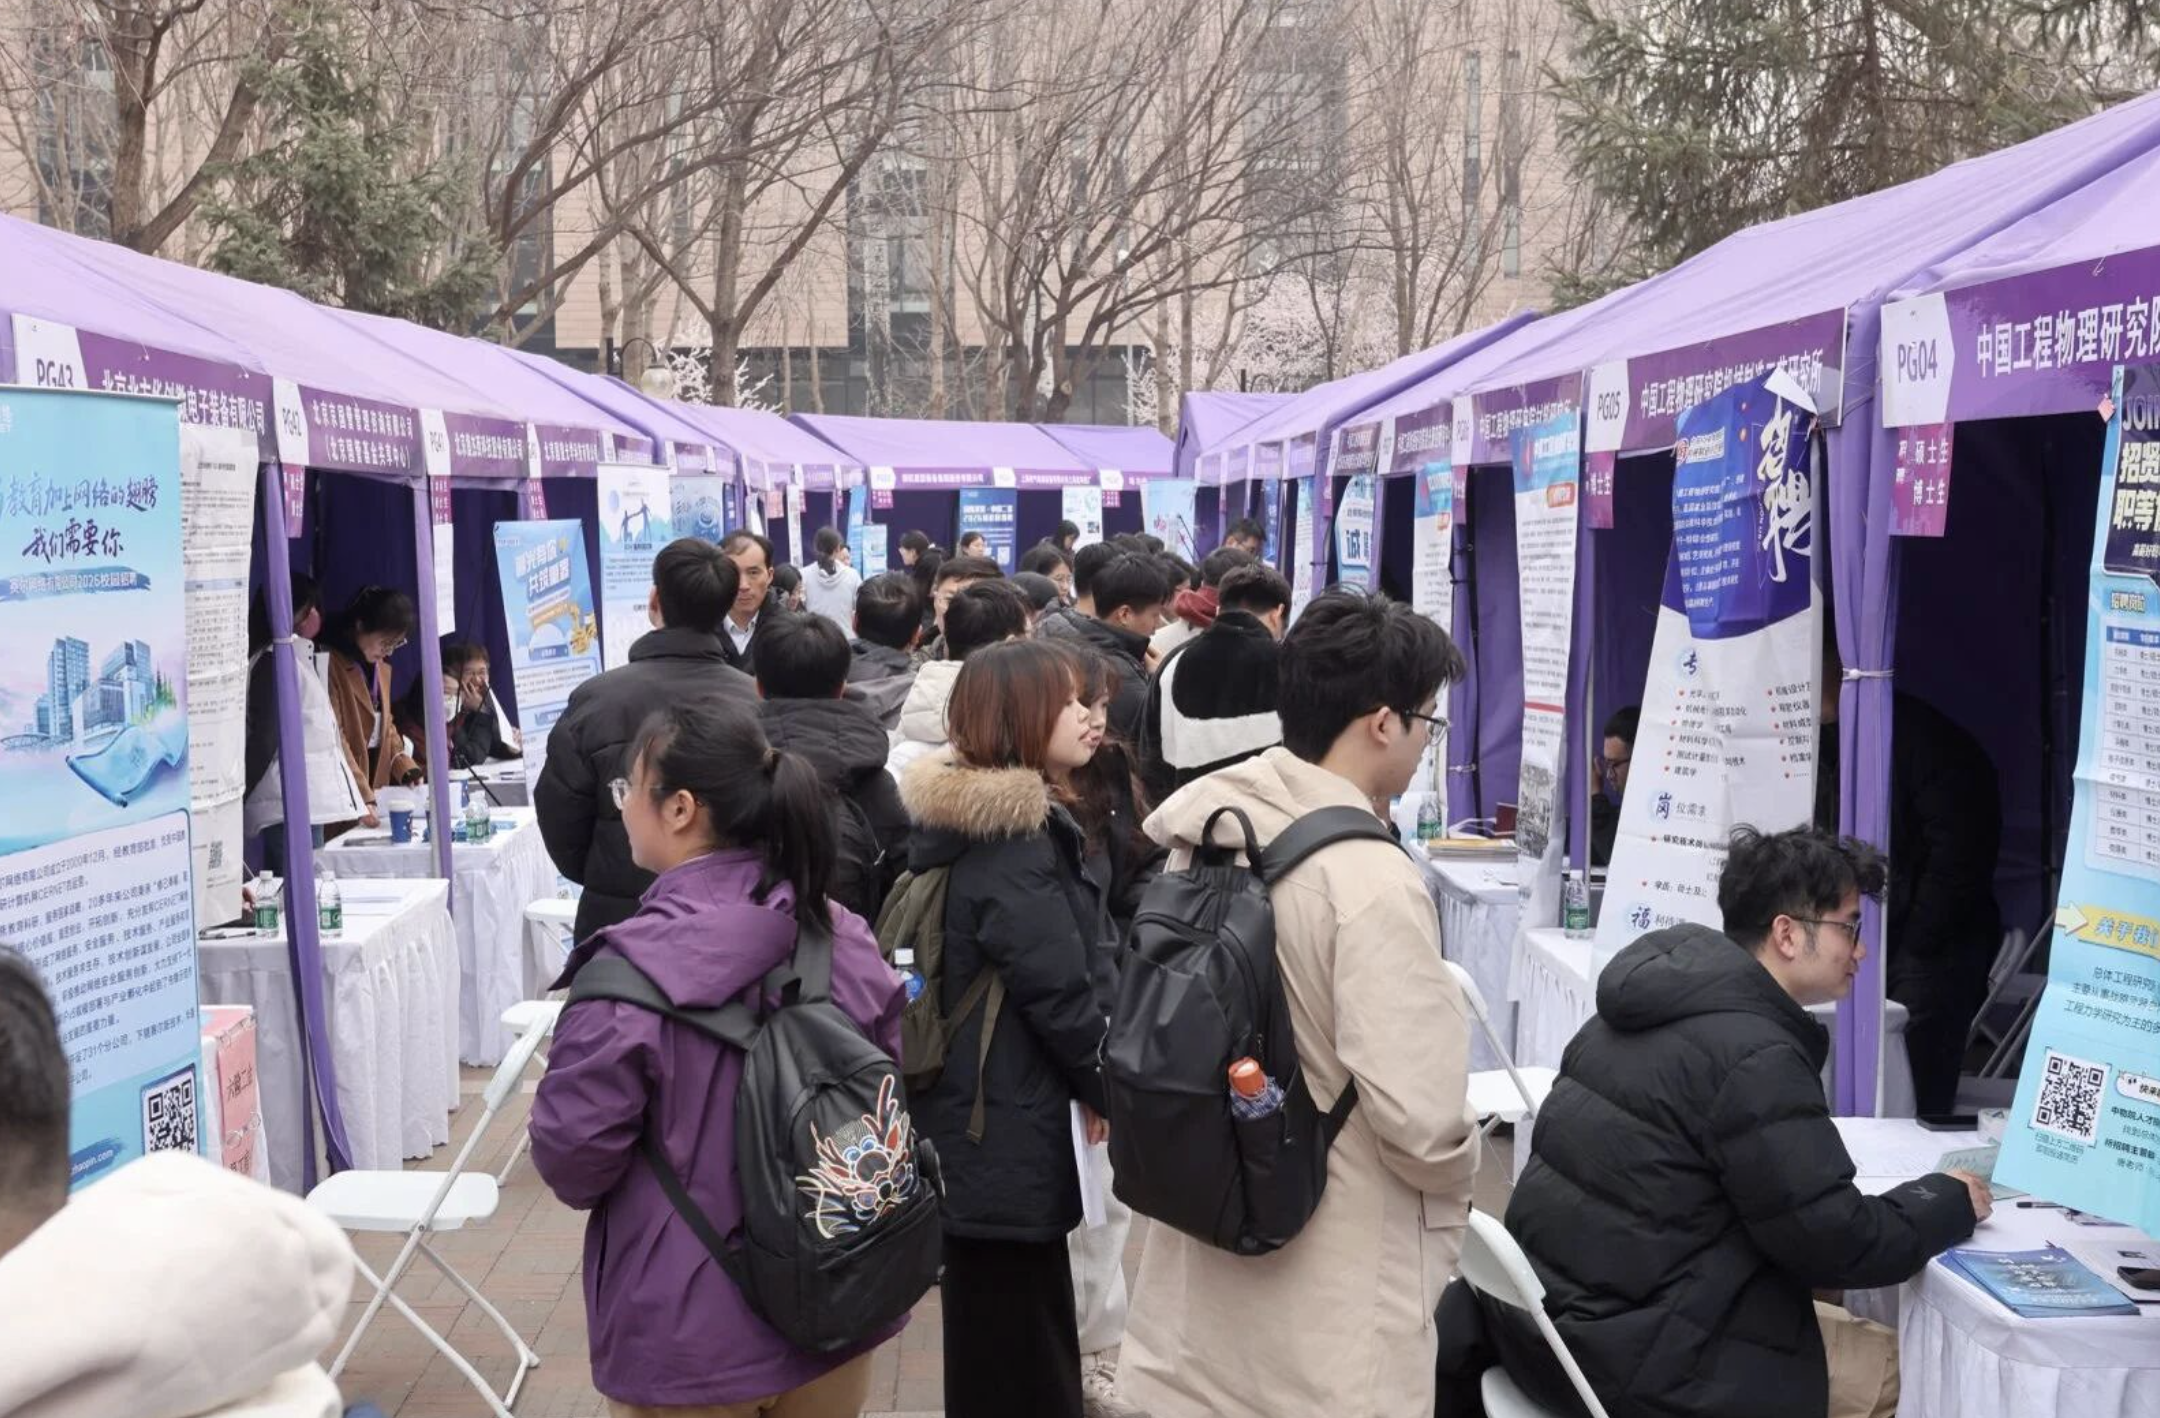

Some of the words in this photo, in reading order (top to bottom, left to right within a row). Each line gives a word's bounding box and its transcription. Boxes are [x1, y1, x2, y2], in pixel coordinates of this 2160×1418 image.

[1897, 338, 1938, 383] PG04
[1597, 390, 1621, 421] PG05
[1914, 436, 1950, 466] 硕士生
[0, 474, 158, 518] 教育加上网络的翅膀
[1591, 471, 1612, 496] 博士生
[1913, 477, 1946, 506] 博士生
[2113, 488, 2160, 531] 职等
[23, 519, 125, 565] 我们需要你
